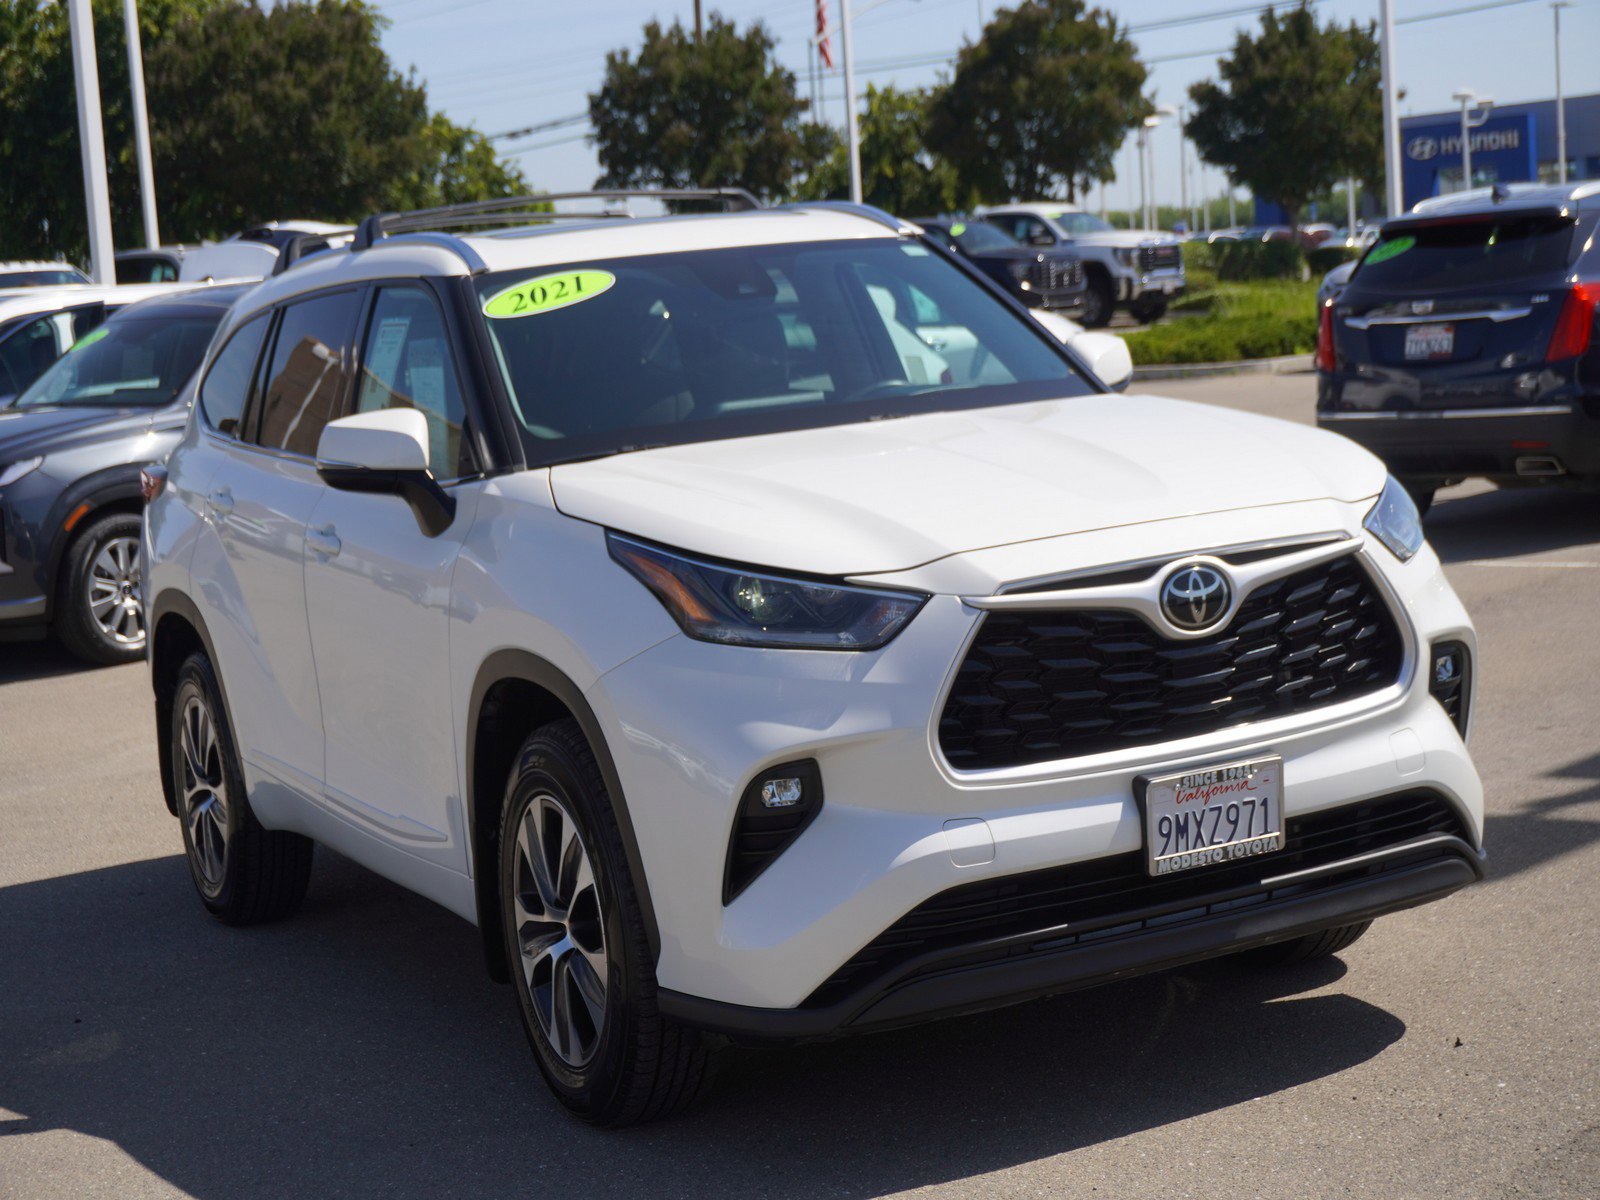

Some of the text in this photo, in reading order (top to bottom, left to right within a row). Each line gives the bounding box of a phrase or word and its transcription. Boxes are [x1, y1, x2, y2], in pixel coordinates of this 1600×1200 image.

[1440, 129, 1519, 155] HYUNDAI
[509, 275, 584, 313] 2021
[1176, 780, 1257, 806] California
[1182, 769, 1218, 788] SINCE
[1158, 797, 1272, 857] 9MXZ971
[1158, 836, 1278, 873] MODESTO TOYOTA
